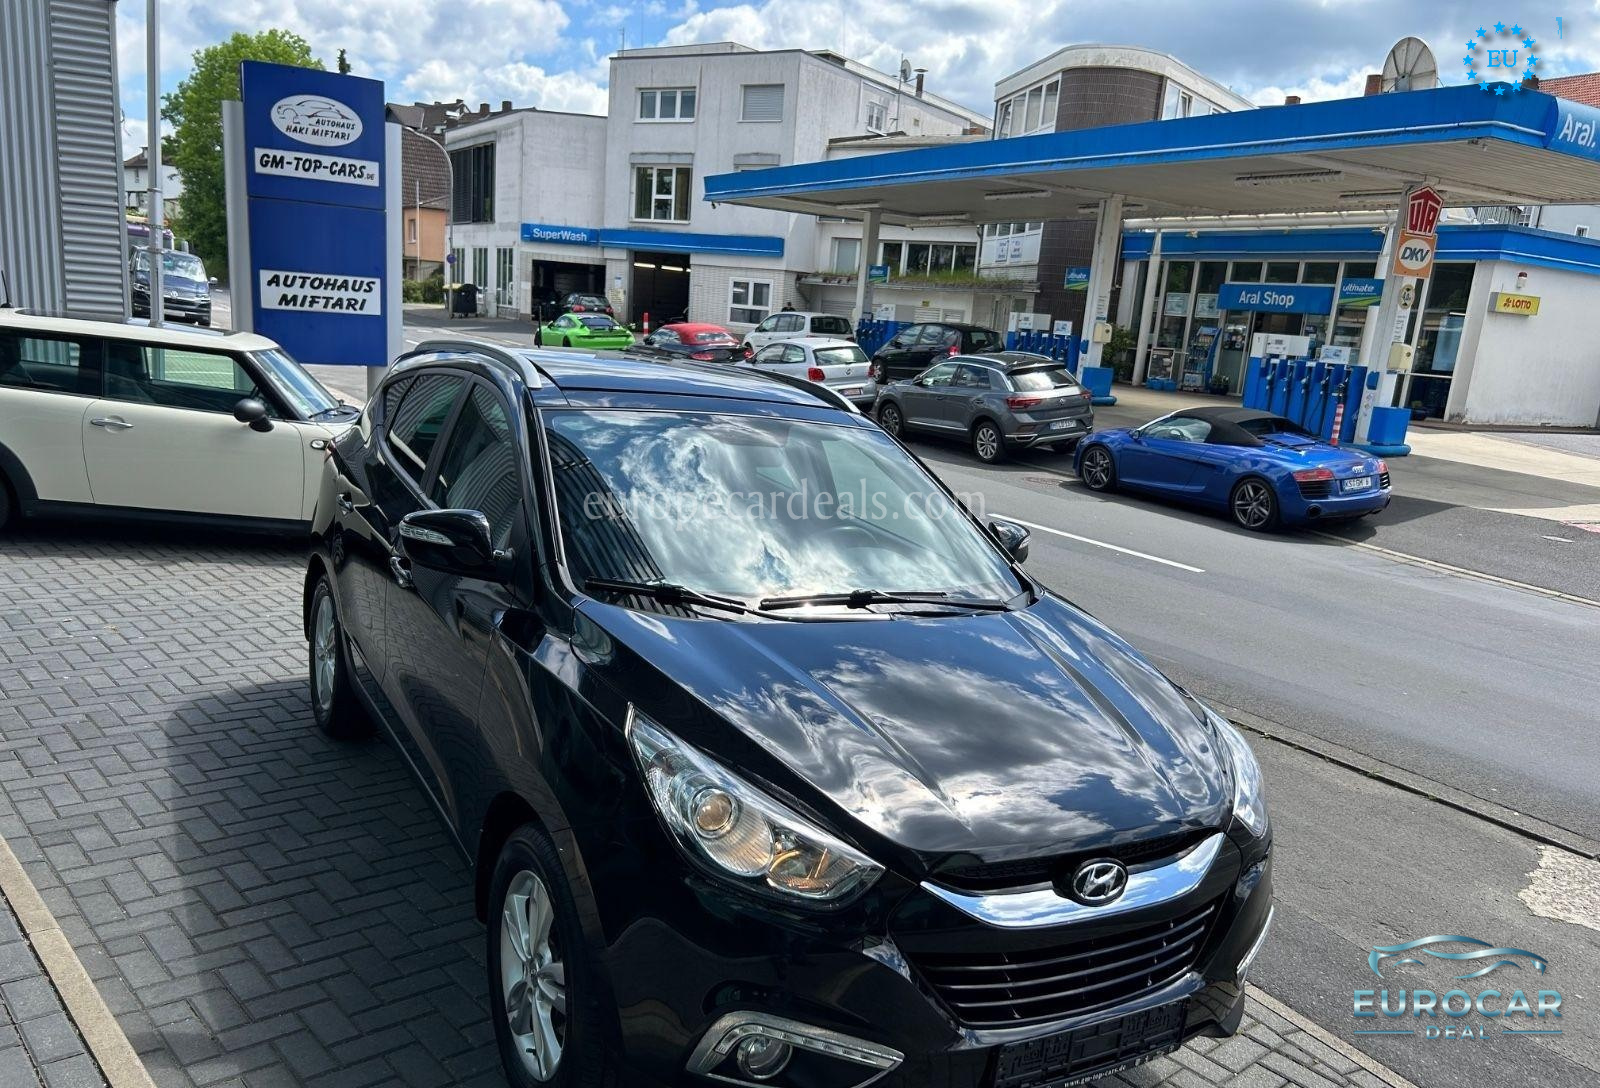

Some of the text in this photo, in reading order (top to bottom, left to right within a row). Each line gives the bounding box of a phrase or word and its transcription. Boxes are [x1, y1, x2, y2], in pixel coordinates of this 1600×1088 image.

[315, 118, 356, 131] AUTOHAUS
[285, 125, 351, 141] HAKI MIFTARI
[532, 227, 588, 242] SuperWash
[1401, 246, 1430, 263] DKV
[266, 273, 376, 294] AUTOHAUS
[277, 293, 368, 312] MIFTARI
[1238, 290, 1295, 309] Aral Shop
[1511, 299, 1532, 310] LOTTO
